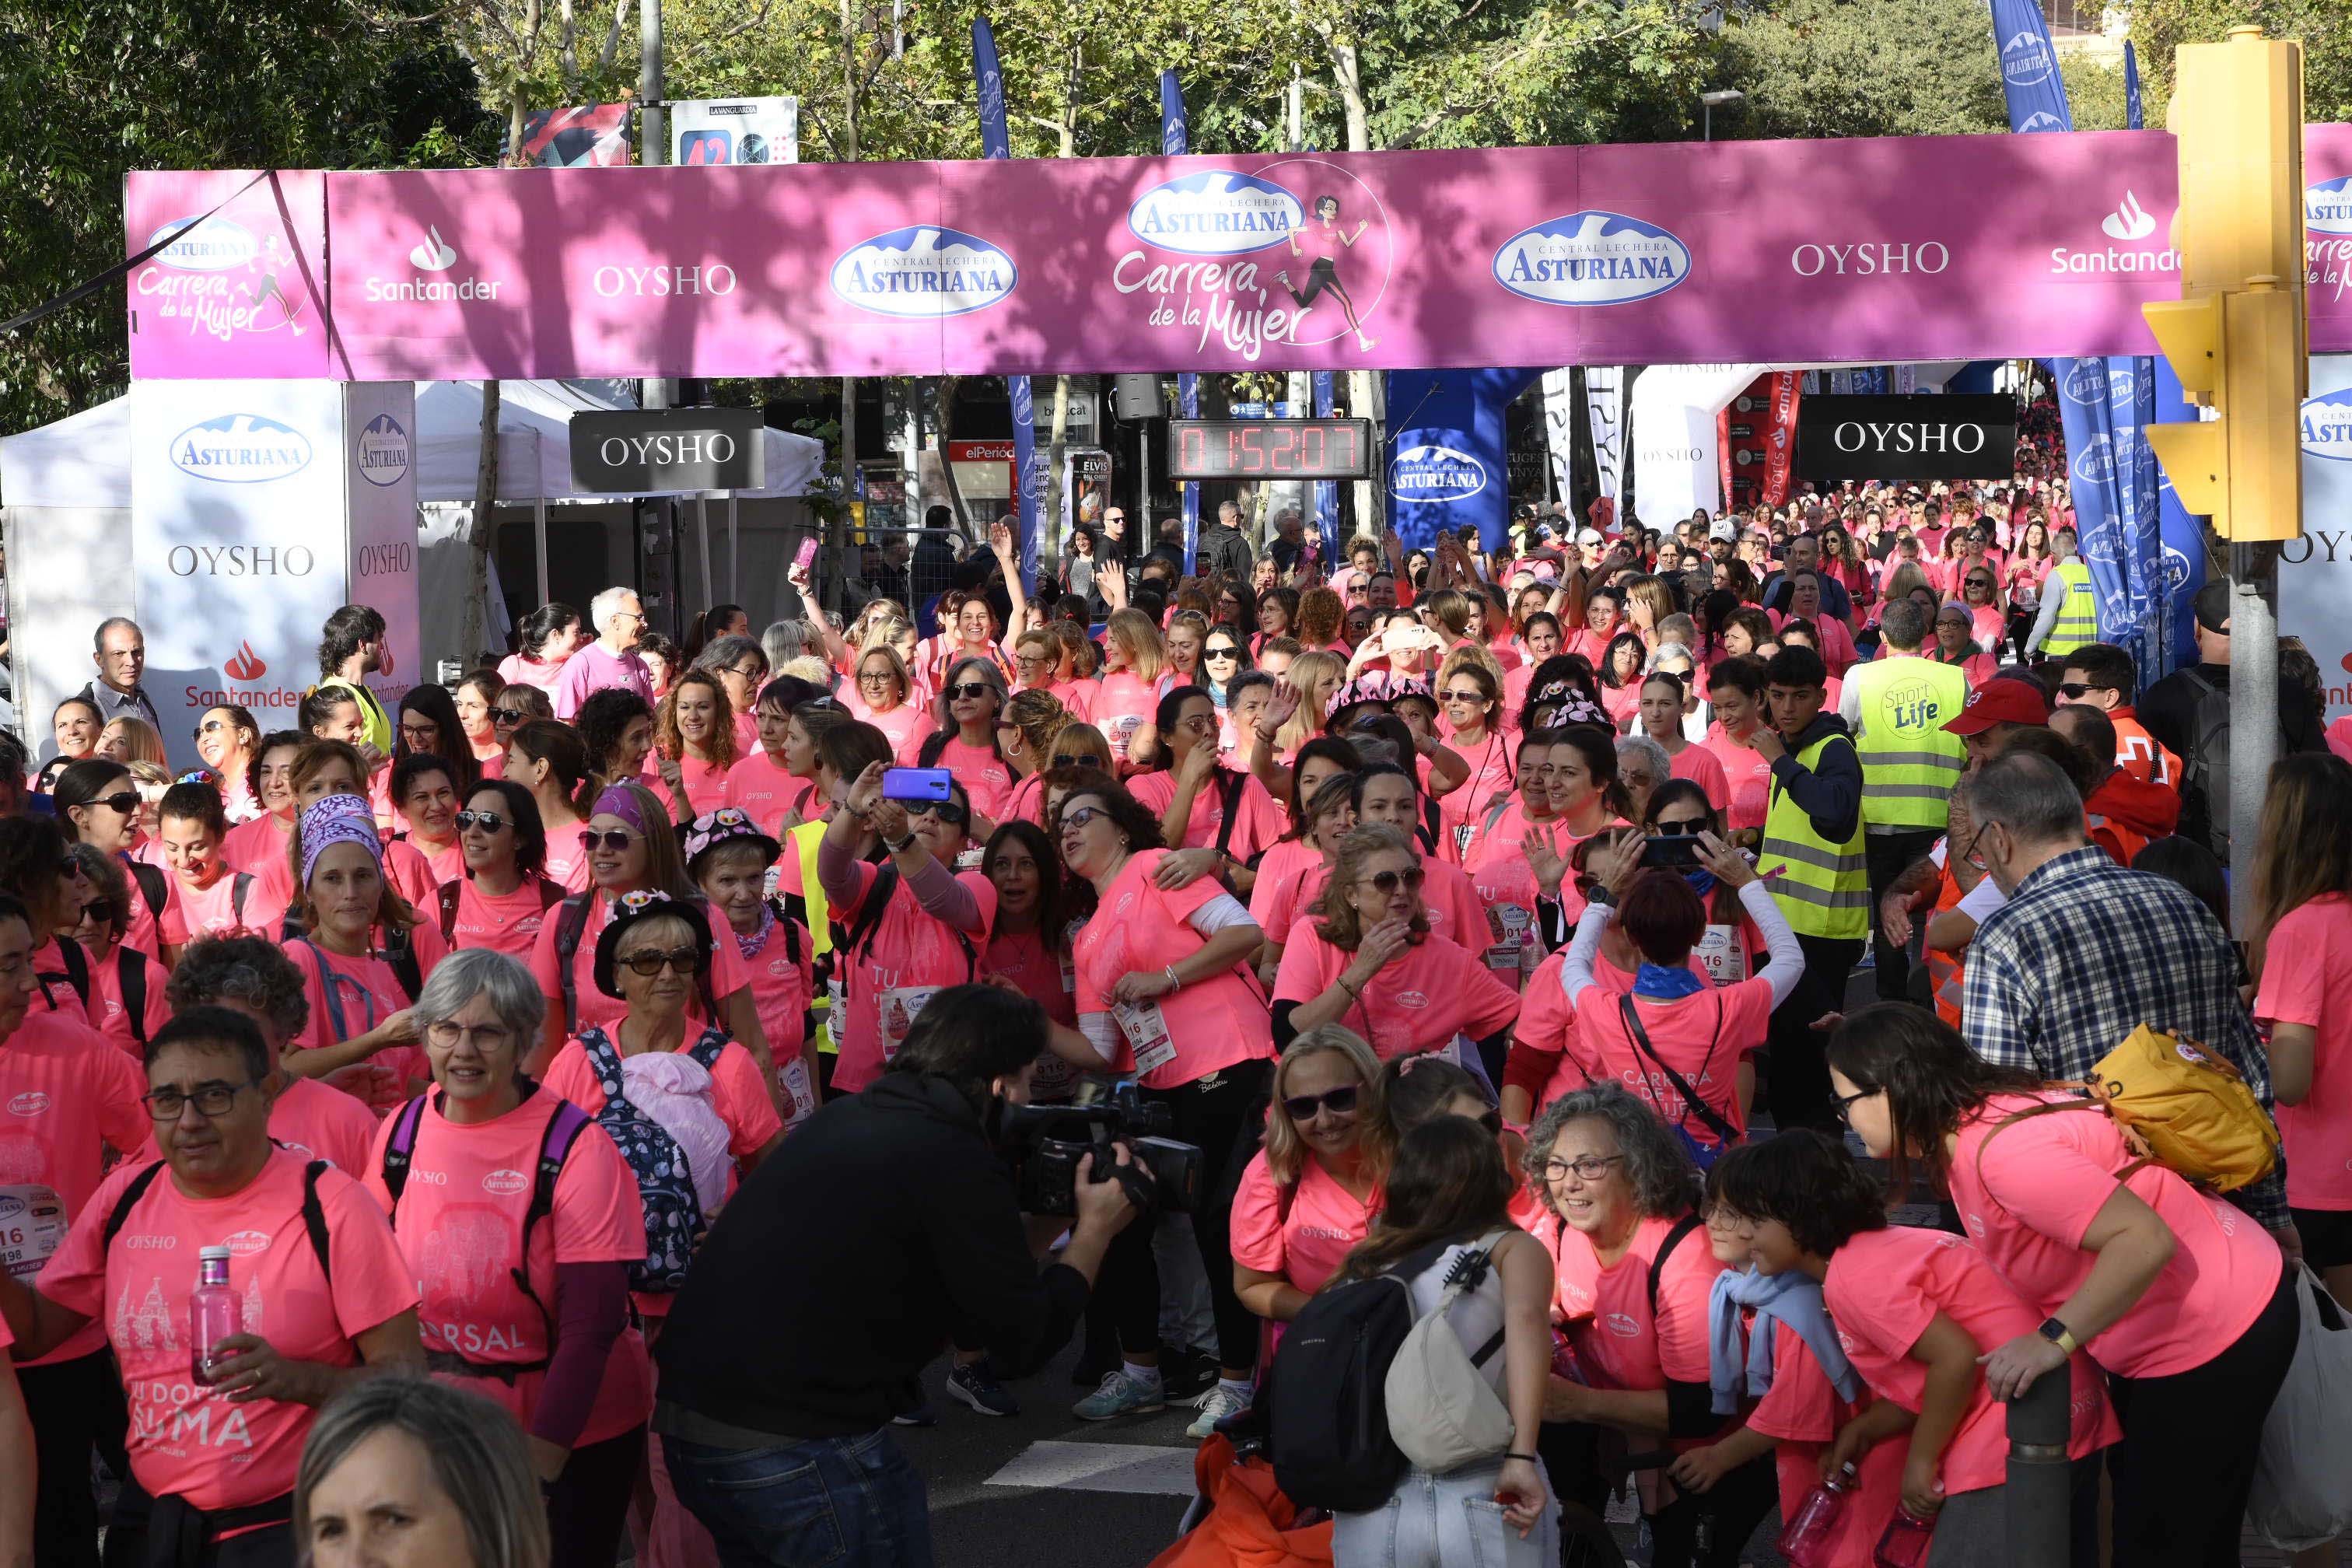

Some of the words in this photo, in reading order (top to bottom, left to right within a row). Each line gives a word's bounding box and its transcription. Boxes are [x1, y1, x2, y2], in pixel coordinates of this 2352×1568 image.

[1142, 203, 1290, 234] ASTURIANA
[873, 257, 933, 267] CENTRAL
[938, 256, 996, 265] LECHERA
[1539, 244, 1599, 254] CENTRAL
[1606, 243, 1668, 253] LECHERA
[1792, 241, 1949, 276] OYSHO
[2306, 239, 2352, 262] arre
[846, 260, 1003, 293] ASTURIANA
[1114, 250, 1258, 294] Carrera
[1508, 248, 1675, 282] ASTURIANA
[138, 267, 228, 296] Carrera
[366, 276, 501, 303] Santander
[593, 264, 737, 297] OYSHO
[160, 299, 177, 317] de
[180, 298, 193, 317] la
[190, 292, 264, 342] Mujer
[1149, 296, 1176, 326] de
[1182, 296, 1201, 326] la
[1197, 288, 1312, 362] Mujer
[601, 432, 735, 467] OYSHO
[1181, 428, 1355, 471] 01:52:07
[1834, 421, 1985, 454] OYSHO
[180, 440, 302, 465] ASTURIANA
[361, 441, 407, 469] ASTURIANA
[1083, 461, 1108, 471] ELVIS
[1391, 468, 1479, 490] ASTURIANA
[168, 545, 314, 576] OYSHO
[359, 542, 411, 576] OYSHO
[2279, 530, 2352, 565] OY
[186, 686, 307, 708] Santander
[1885, 683, 1930, 711] Sport
[1895, 699, 1938, 729] Life
[1623, 1069, 1712, 1087] CARRRA
[1641, 1087, 1664, 1101] DE
[127, 1234, 177, 1249] OYSHO
[1301, 1227, 1349, 1241] OYSHO
